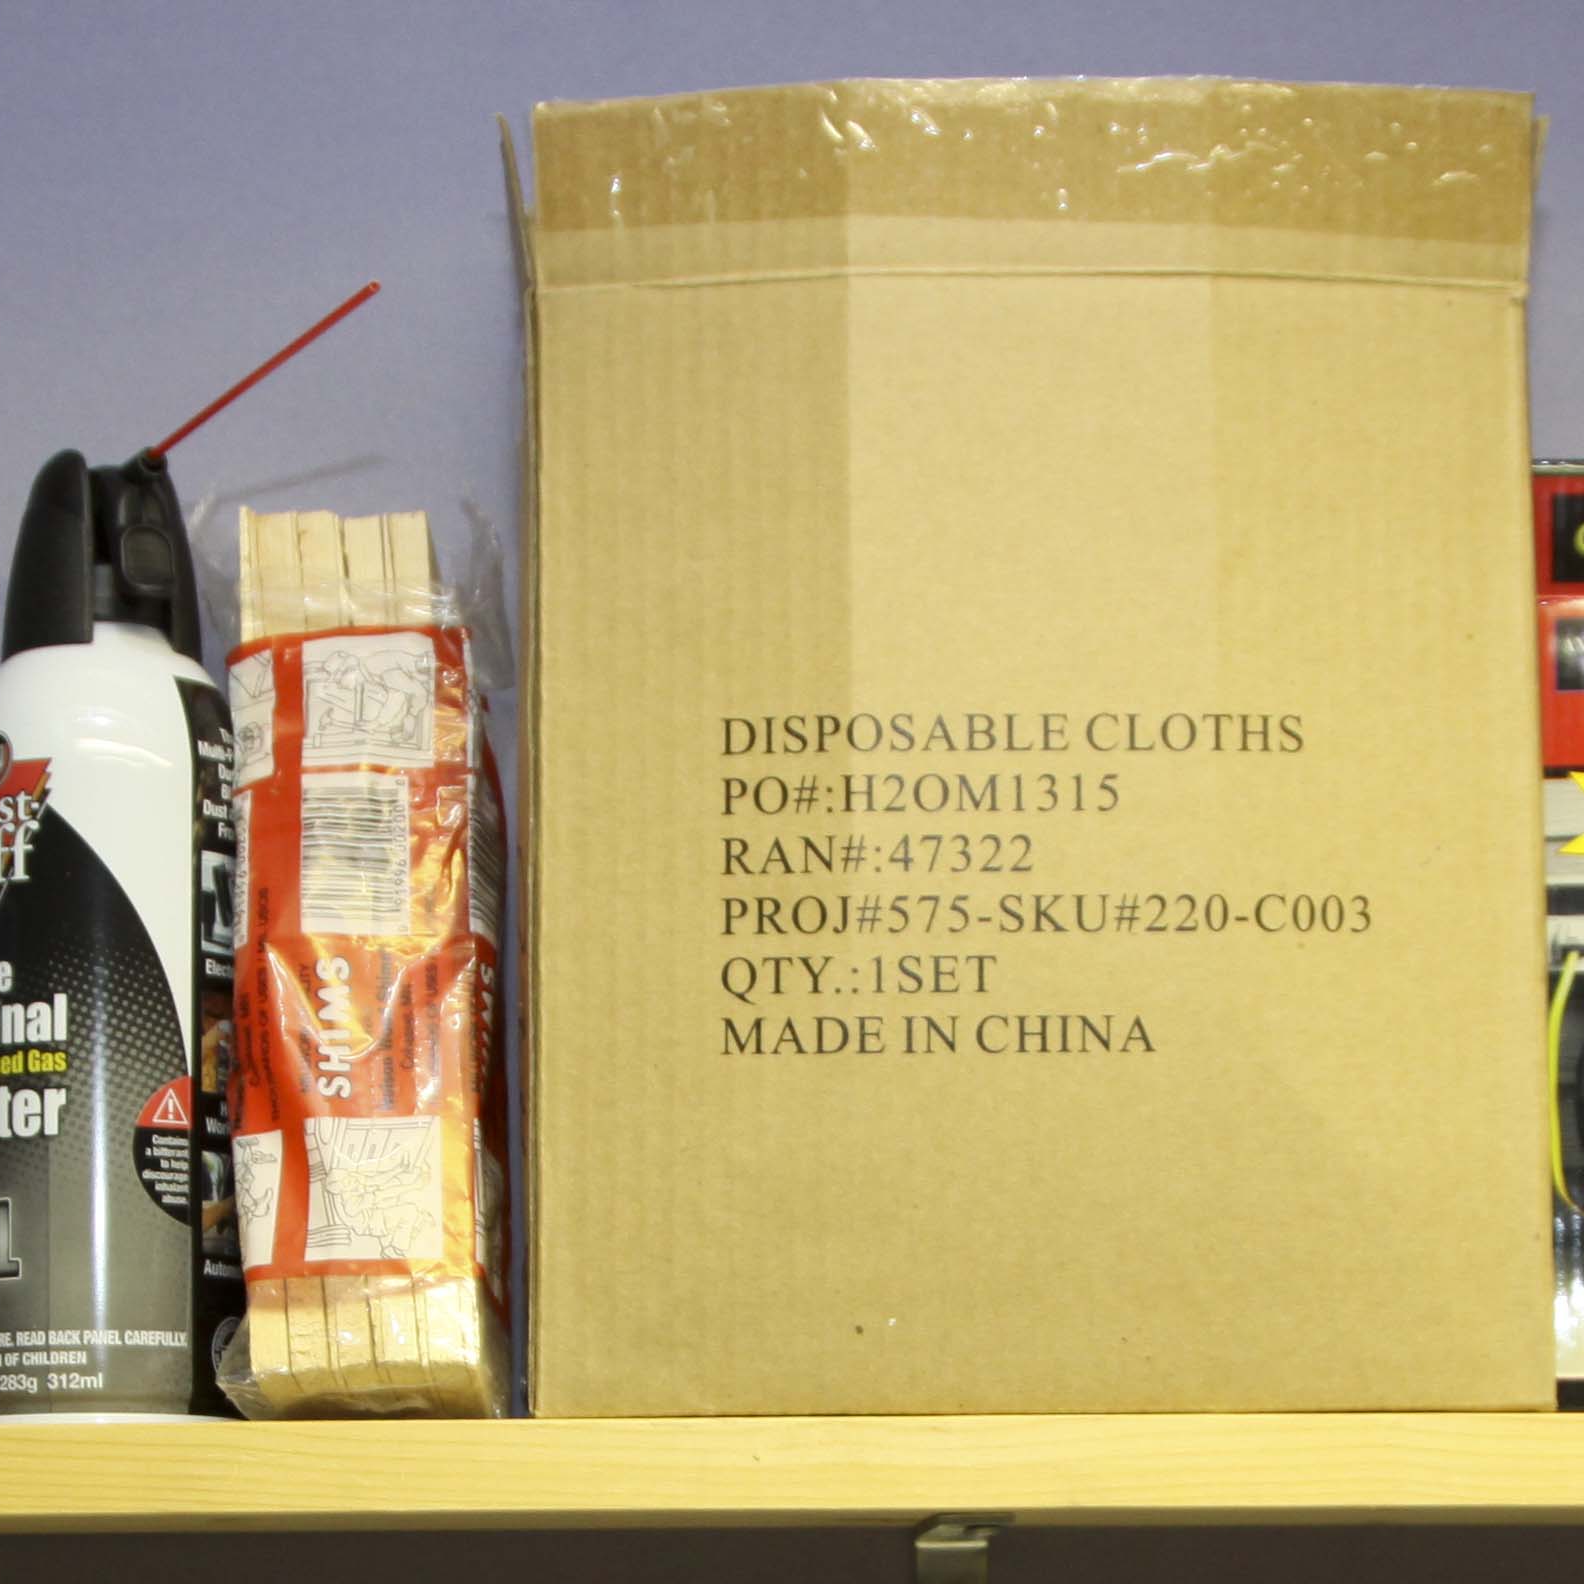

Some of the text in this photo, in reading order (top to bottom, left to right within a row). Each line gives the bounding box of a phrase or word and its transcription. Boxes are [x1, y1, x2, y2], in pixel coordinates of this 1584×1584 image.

[720, 712, 1305, 757] DISPOSABLE CLOTHS
[721, 833, 1036, 877] RAN#:47322
[721, 894, 1374, 935] PROJ#575-SKU#220-C003
[721, 954, 997, 1005] QTY.:1SET
[317, 955, 353, 1100] SHIMS
[721, 1014, 1157, 1056] MADE IN CHINA
[28, 1050, 67, 1074] Gas
[16, 1330, 188, 1347] READ BACK PANEL CAREFULLY.
[4, 1352, 19, 1368] OF
[22, 1351, 87, 1366] CHILDREN
[0, 1374, 38, 1393] 283g
[47, 1372, 103, 1391] 312ml
